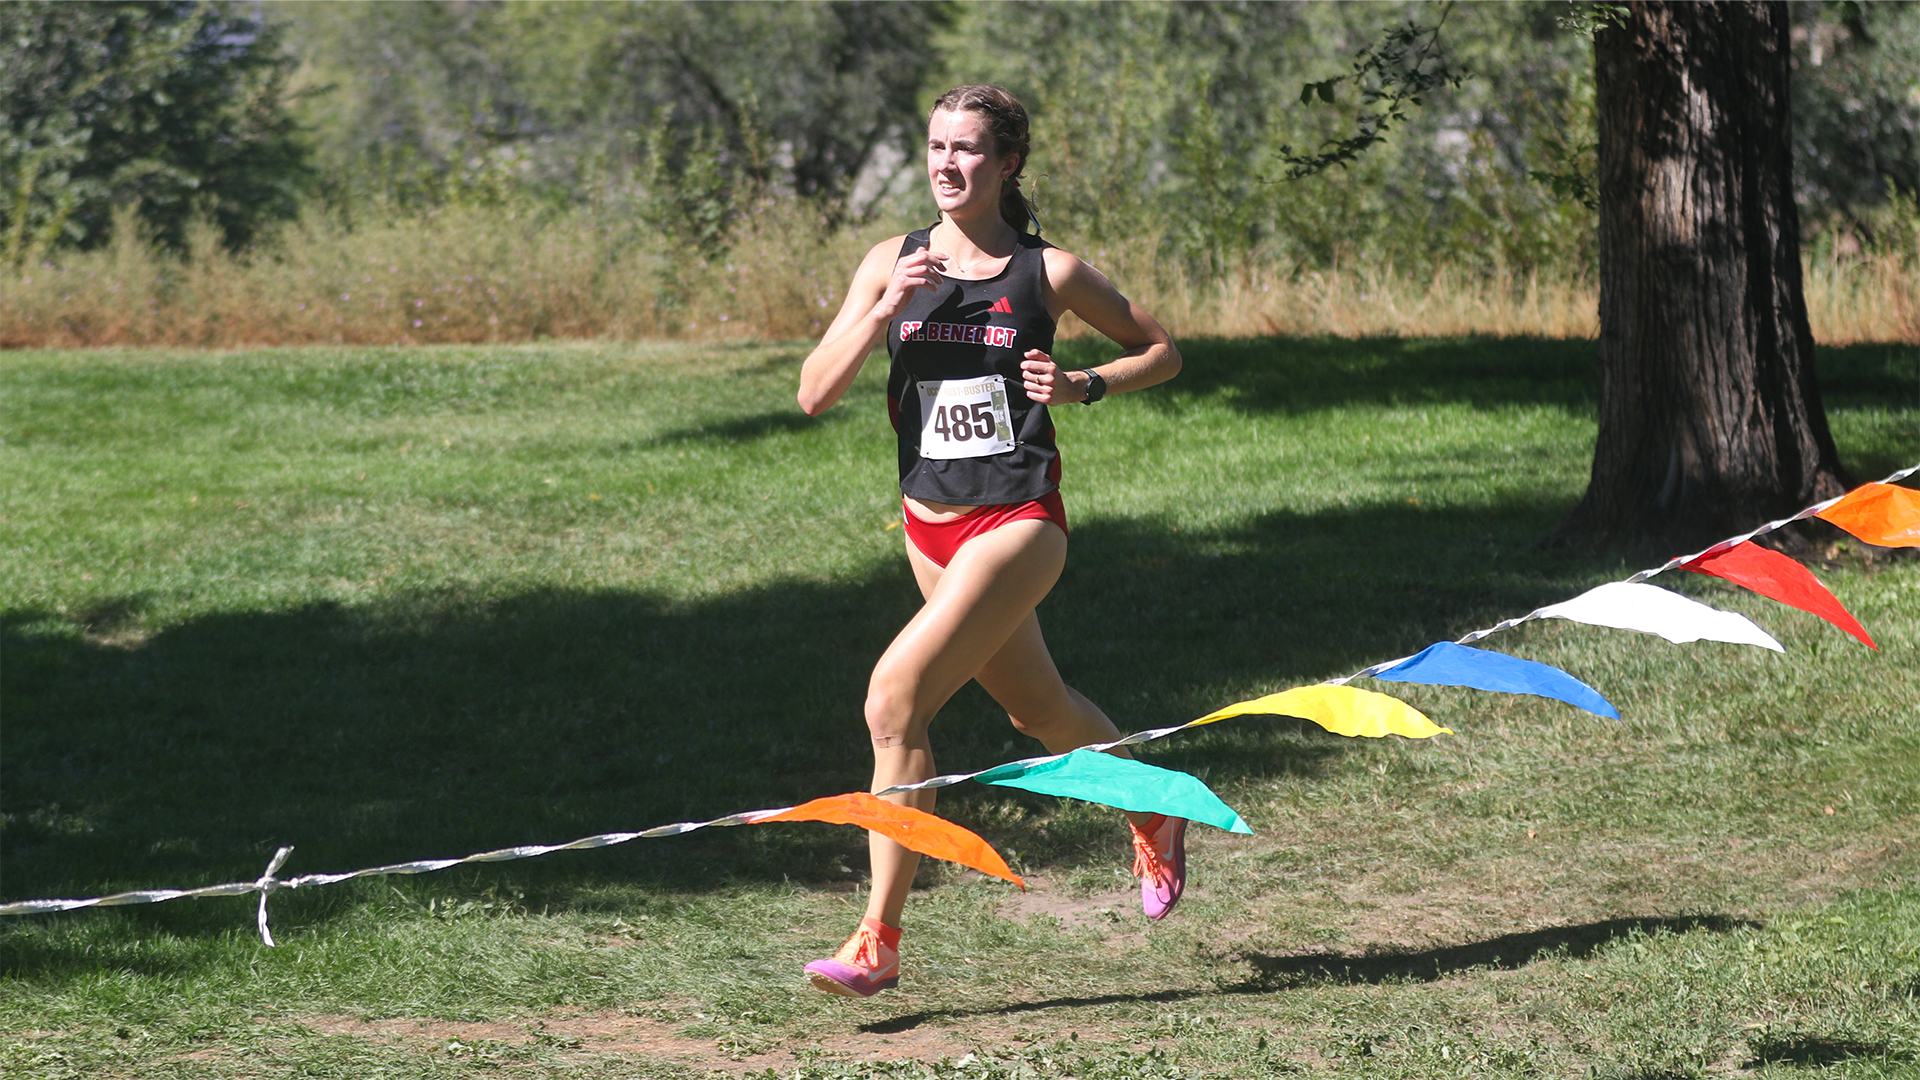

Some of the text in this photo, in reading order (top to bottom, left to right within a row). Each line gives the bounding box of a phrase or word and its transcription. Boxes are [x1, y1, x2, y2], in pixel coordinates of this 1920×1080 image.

[900, 321, 1018, 348] ST. BENEDICT
[934, 401, 995, 442] 485
